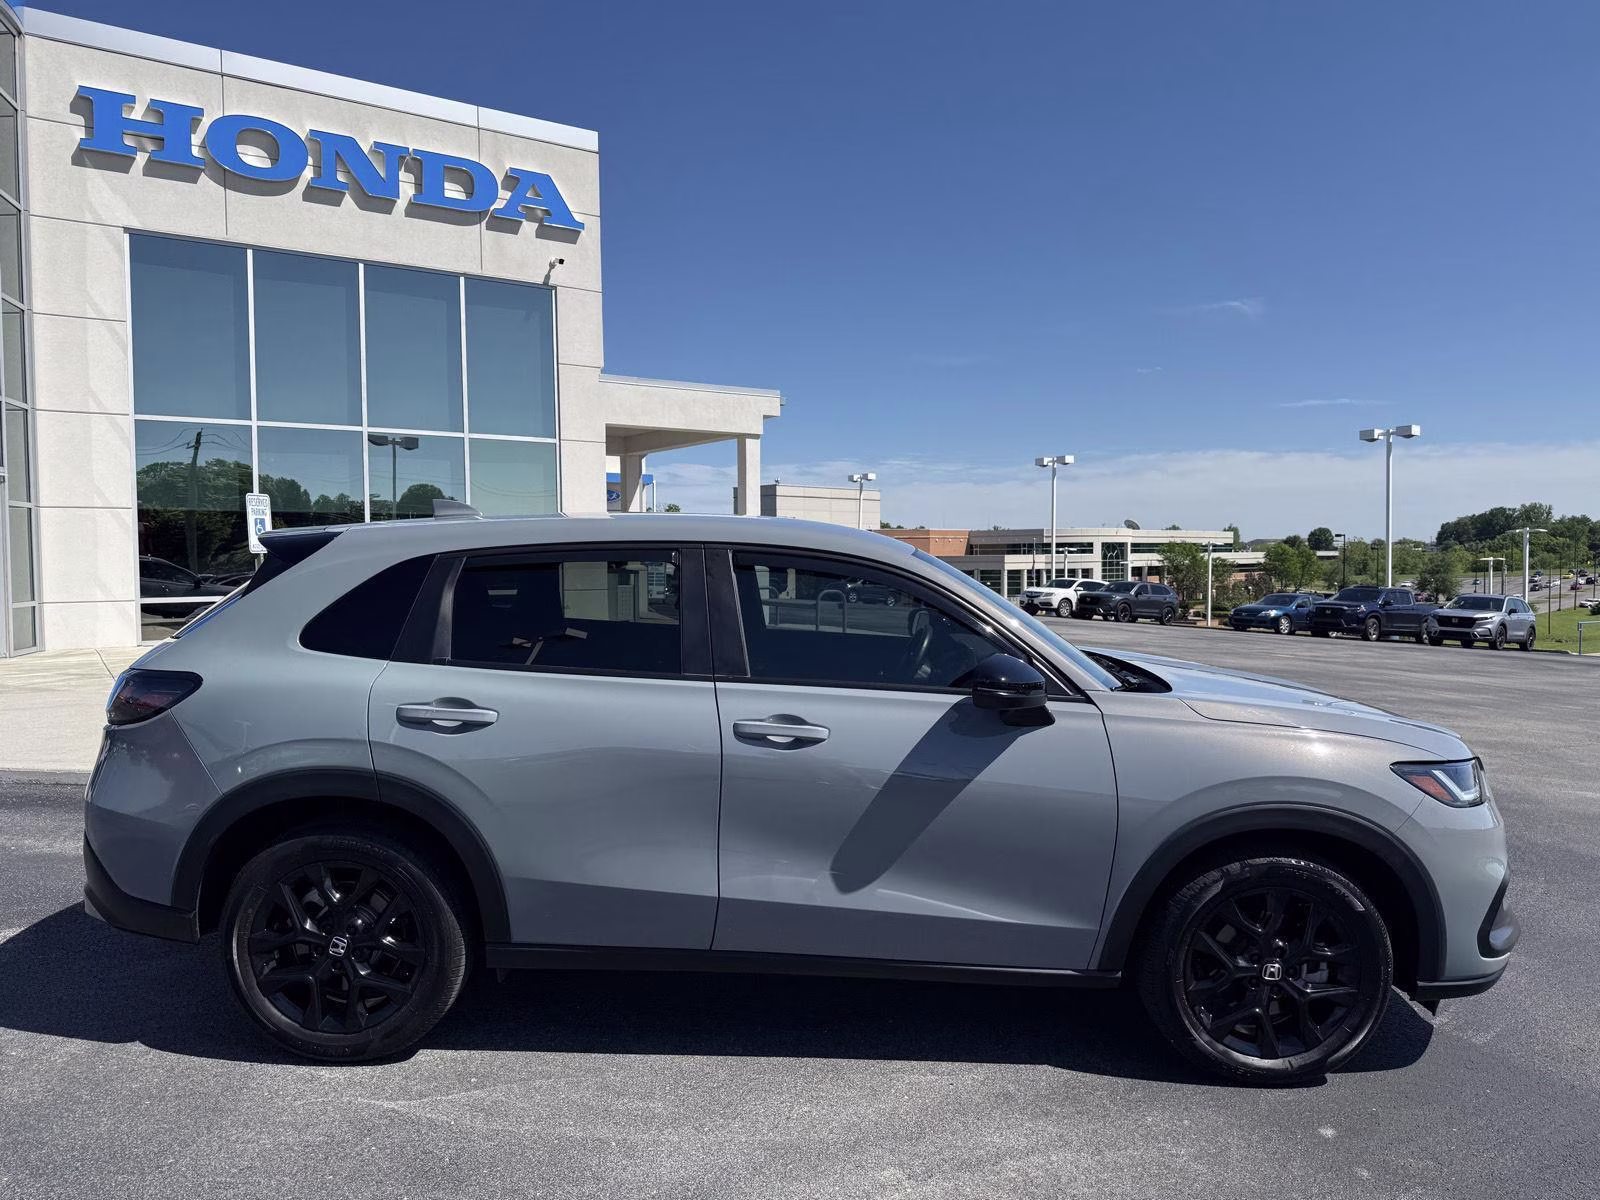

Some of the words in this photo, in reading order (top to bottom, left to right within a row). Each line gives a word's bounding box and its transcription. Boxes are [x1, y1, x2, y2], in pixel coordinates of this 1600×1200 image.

[78, 85, 584, 231] HONDA
[248, 497, 269, 507] RESERVED
[251, 507, 267, 517] PARKING
